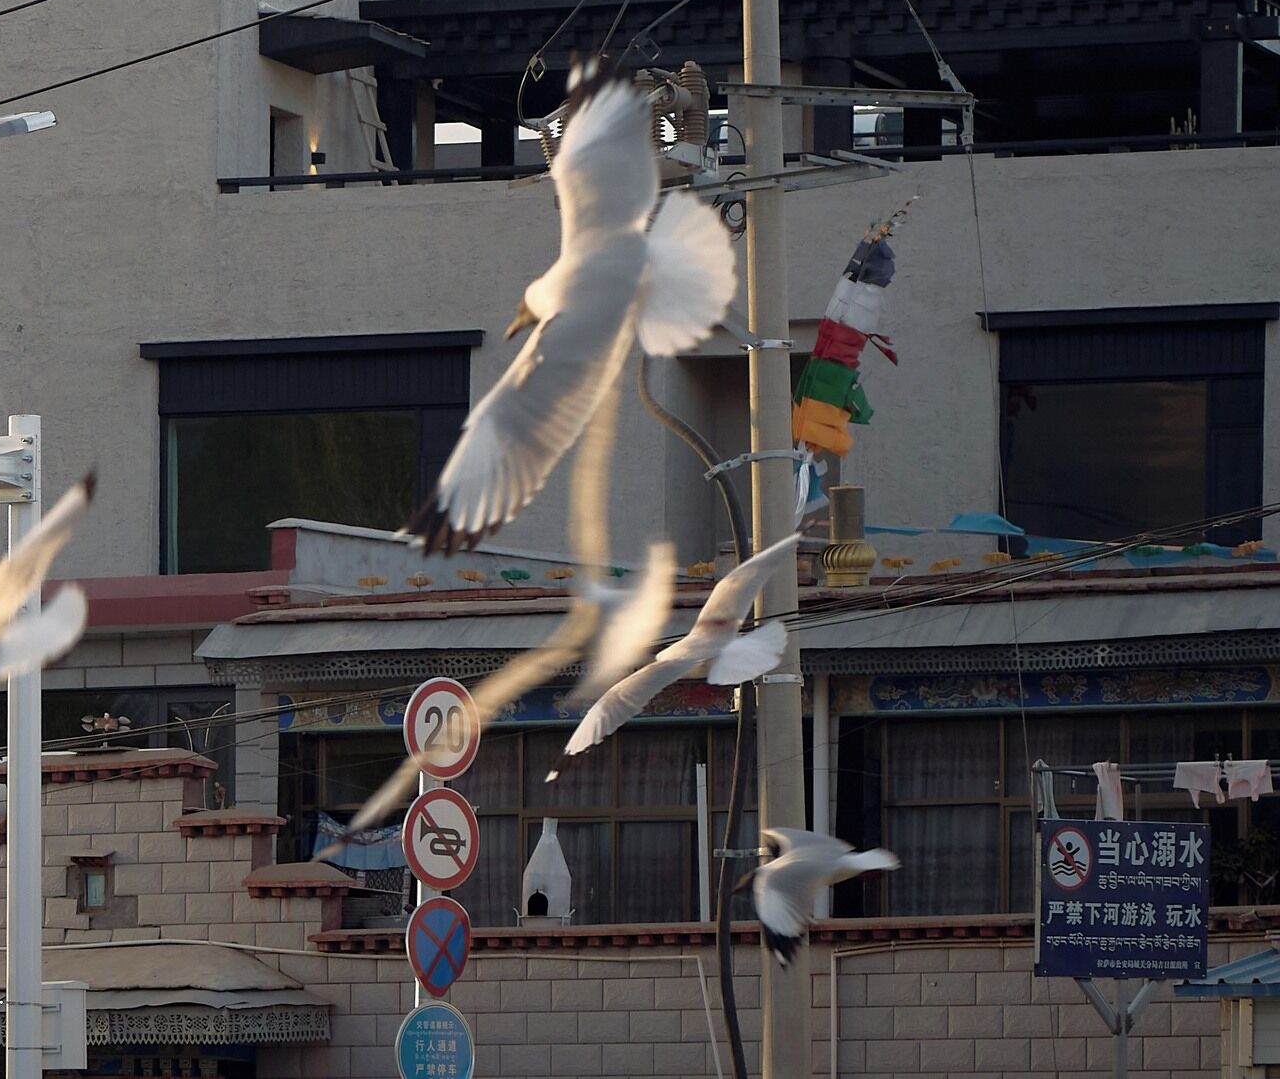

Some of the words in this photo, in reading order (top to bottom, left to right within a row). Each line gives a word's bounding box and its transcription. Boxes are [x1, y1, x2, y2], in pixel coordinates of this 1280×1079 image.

[425, 706, 464, 753] 20
[1098, 829, 1204, 868] 当心溺水
[1046, 901, 1157, 926] 严禁下河游泳
[1166, 904, 1202, 927] 玩水
[415, 1039, 457, 1052] 行人通道
[415, 1064, 457, 1077] 严禁停车
